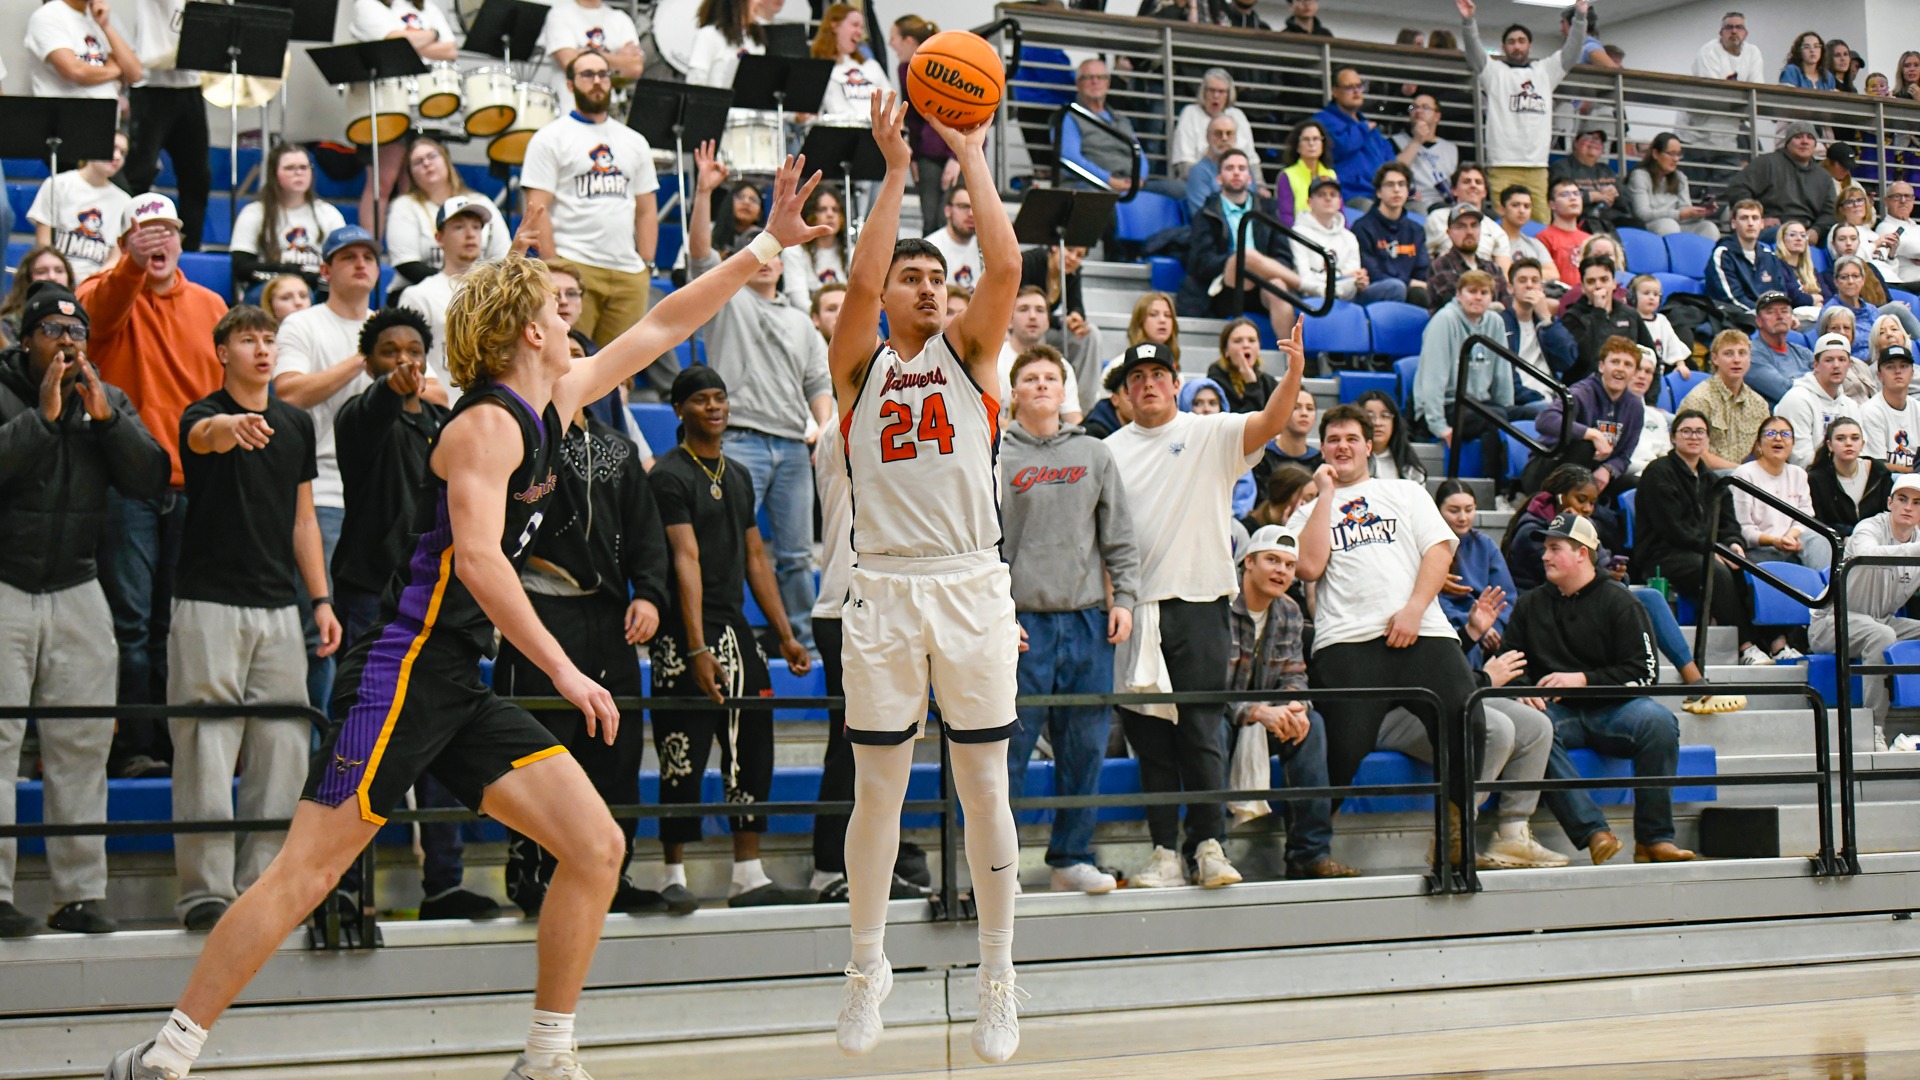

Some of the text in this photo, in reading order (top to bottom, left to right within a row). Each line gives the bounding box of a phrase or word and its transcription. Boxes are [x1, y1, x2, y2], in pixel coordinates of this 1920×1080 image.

[925, 60, 985, 99] Wilson
[55, 229, 112, 260] UMAR
[880, 392, 955, 463] 24
[1010, 466, 1088, 494] Glory
[1331, 519, 1397, 551] UMARY
